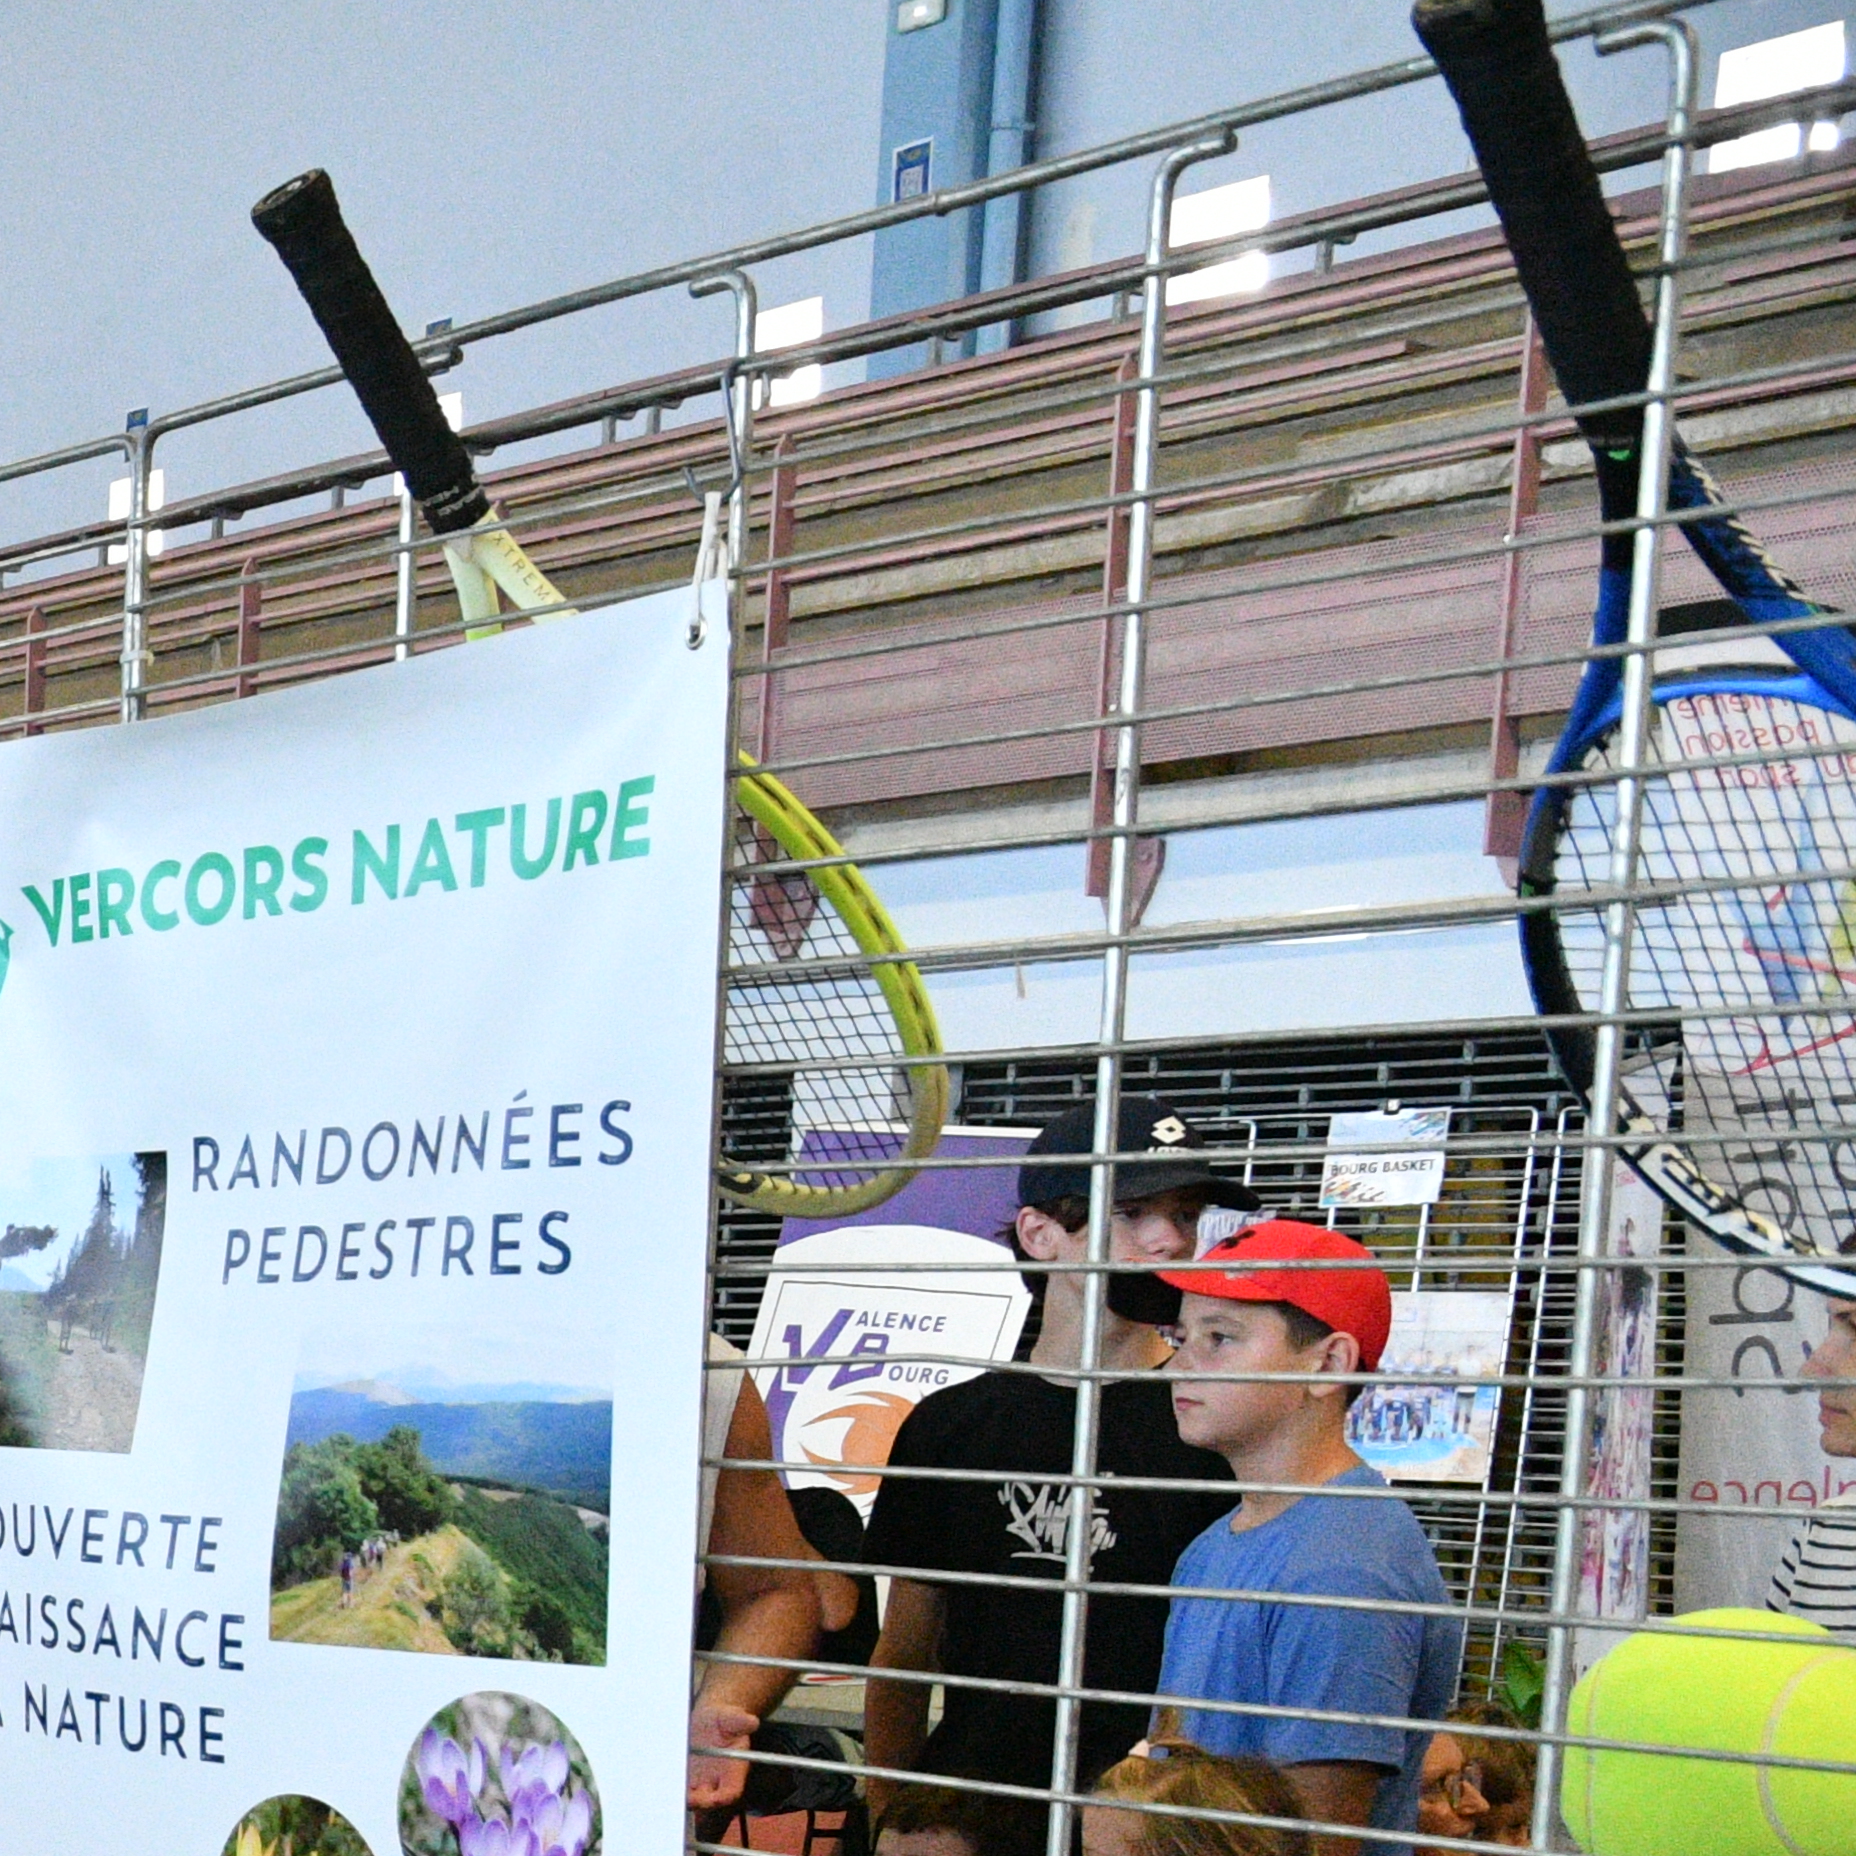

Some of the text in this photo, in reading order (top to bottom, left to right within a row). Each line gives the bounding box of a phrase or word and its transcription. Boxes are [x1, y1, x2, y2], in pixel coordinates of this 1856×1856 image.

[22, 775, 657, 948] VERCORS NATURE
[191, 1091, 635, 1192] RANDONNÉES
[1329, 1158, 1437, 1177] BOURG BASKET
[222, 1209, 572, 1285] PEDESTRES
[24, 1679, 227, 1766] NATURE
